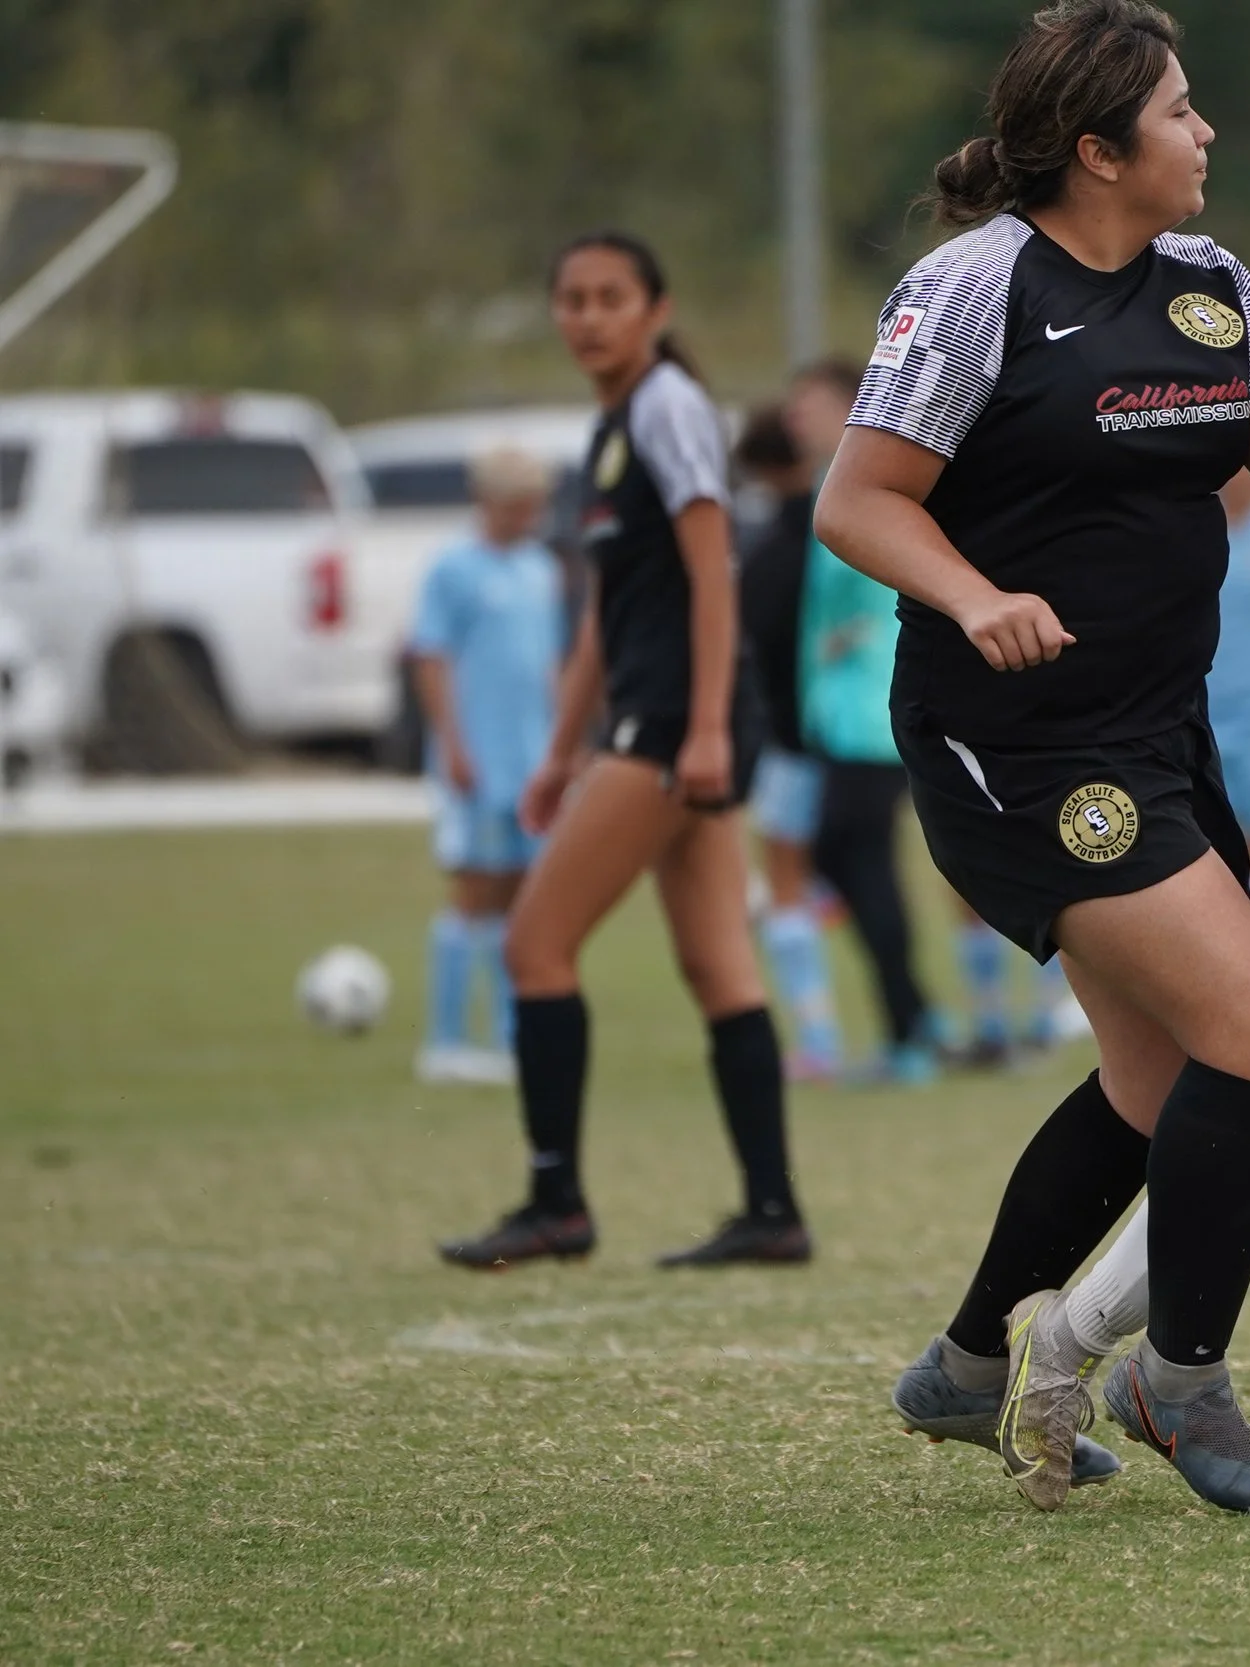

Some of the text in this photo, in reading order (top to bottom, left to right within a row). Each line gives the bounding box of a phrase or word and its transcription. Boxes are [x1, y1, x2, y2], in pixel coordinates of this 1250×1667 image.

[1171, 295, 1220, 315] SOCAL ELITE
[1184, 318, 1241, 346] FOOTBALL CLUB
[1096, 376, 1249, 414] California
[1062, 787, 1116, 825] SOCAL ELITE
[1073, 811, 1136, 860] FOOTBALL CLUB
